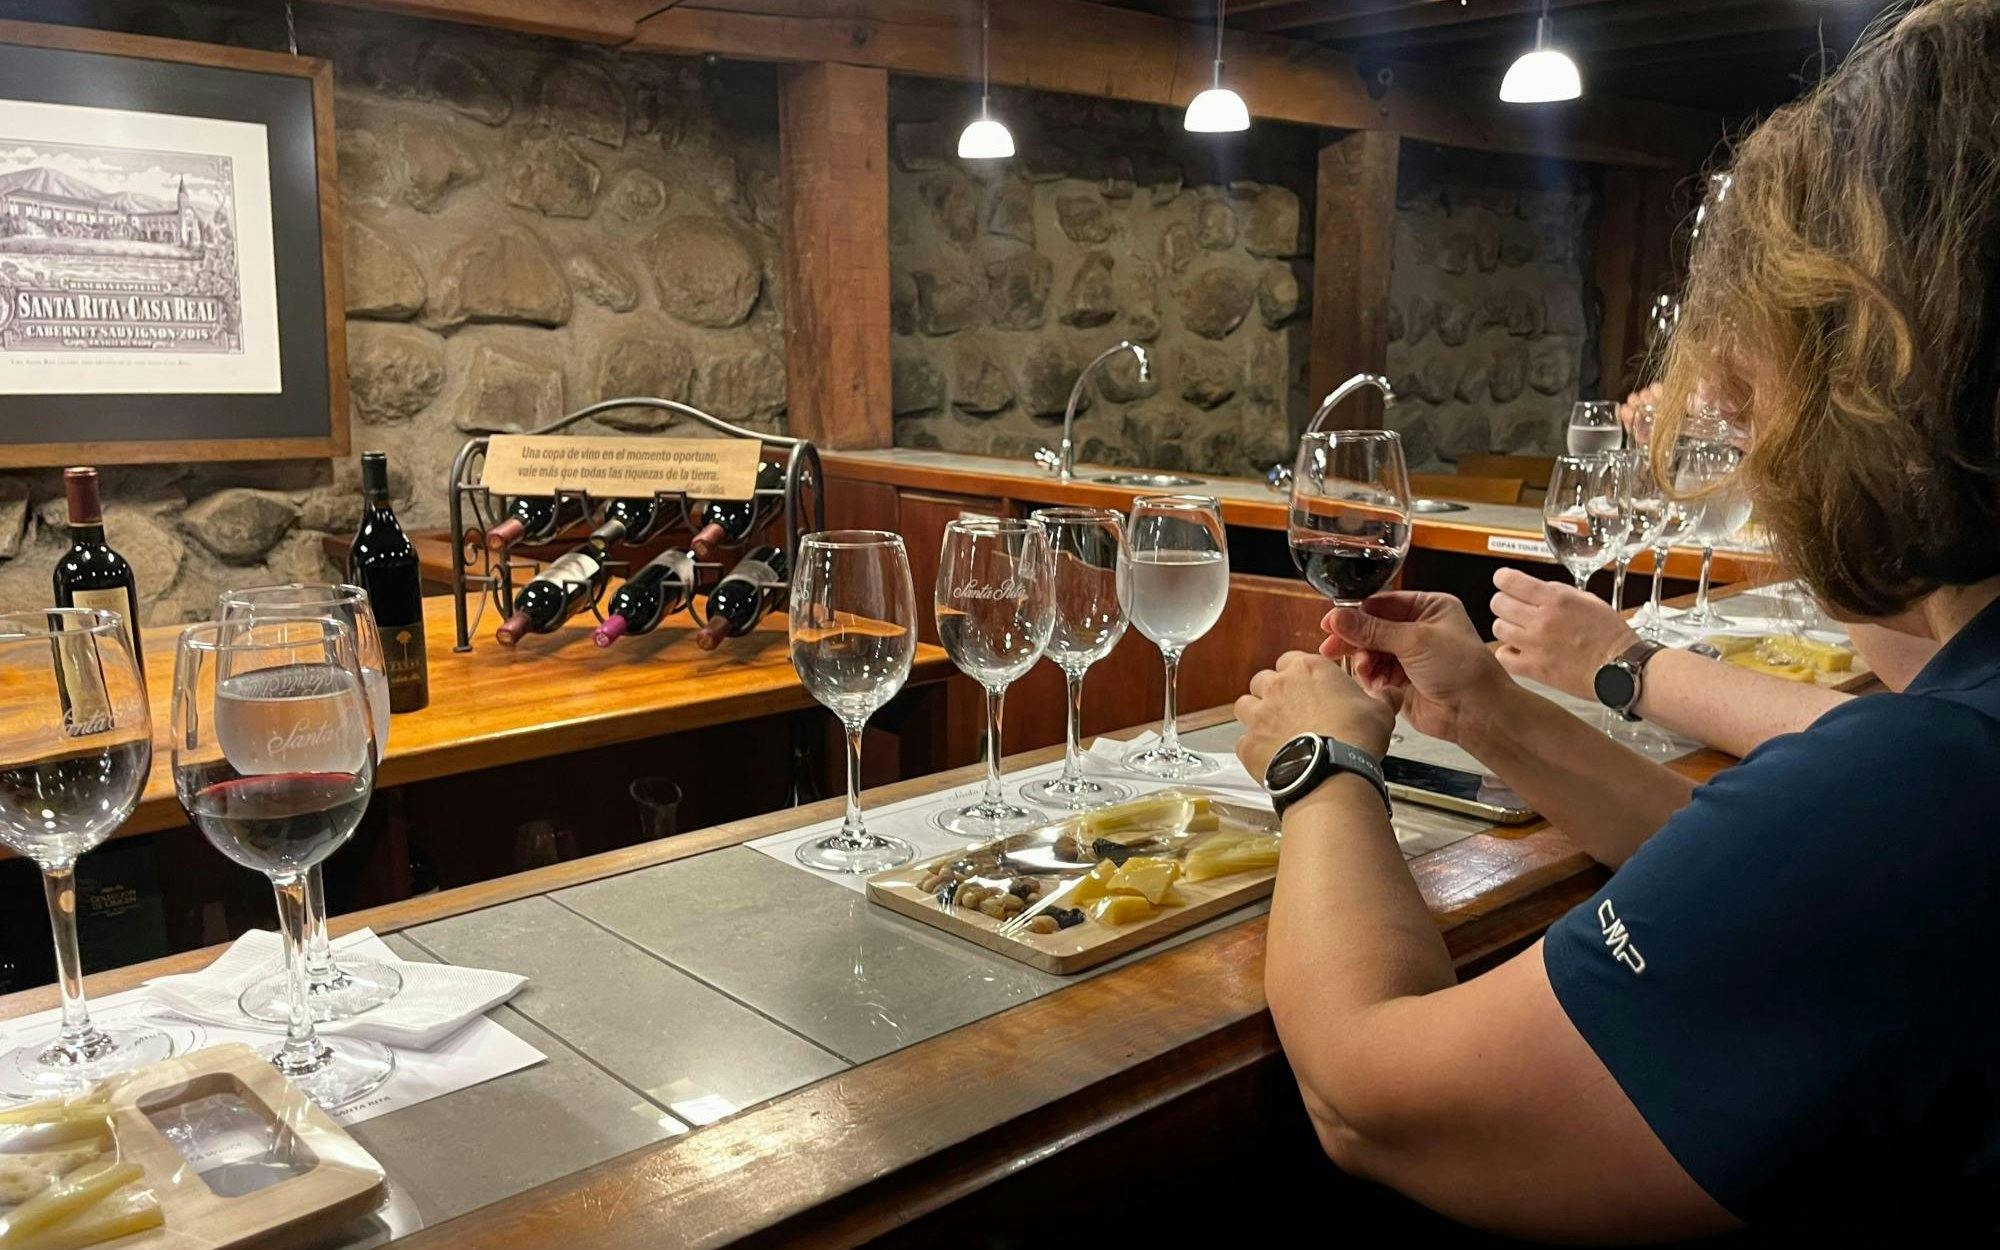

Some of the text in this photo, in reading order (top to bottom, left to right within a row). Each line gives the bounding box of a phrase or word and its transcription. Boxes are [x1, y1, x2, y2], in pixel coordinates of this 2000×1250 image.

[18, 292, 217, 322] SANTA RITA CASA REAL
[26, 325, 96, 338] CABERNET
[521, 446, 719, 465] Una copa de vino en el momento oportuno,
[518, 465, 719, 482] vale más que todas las riquezas de la tierra.
[953, 579, 993, 600] Santa
[267, 717, 335, 758] Santa
[1598, 899, 1646, 976] CMP
